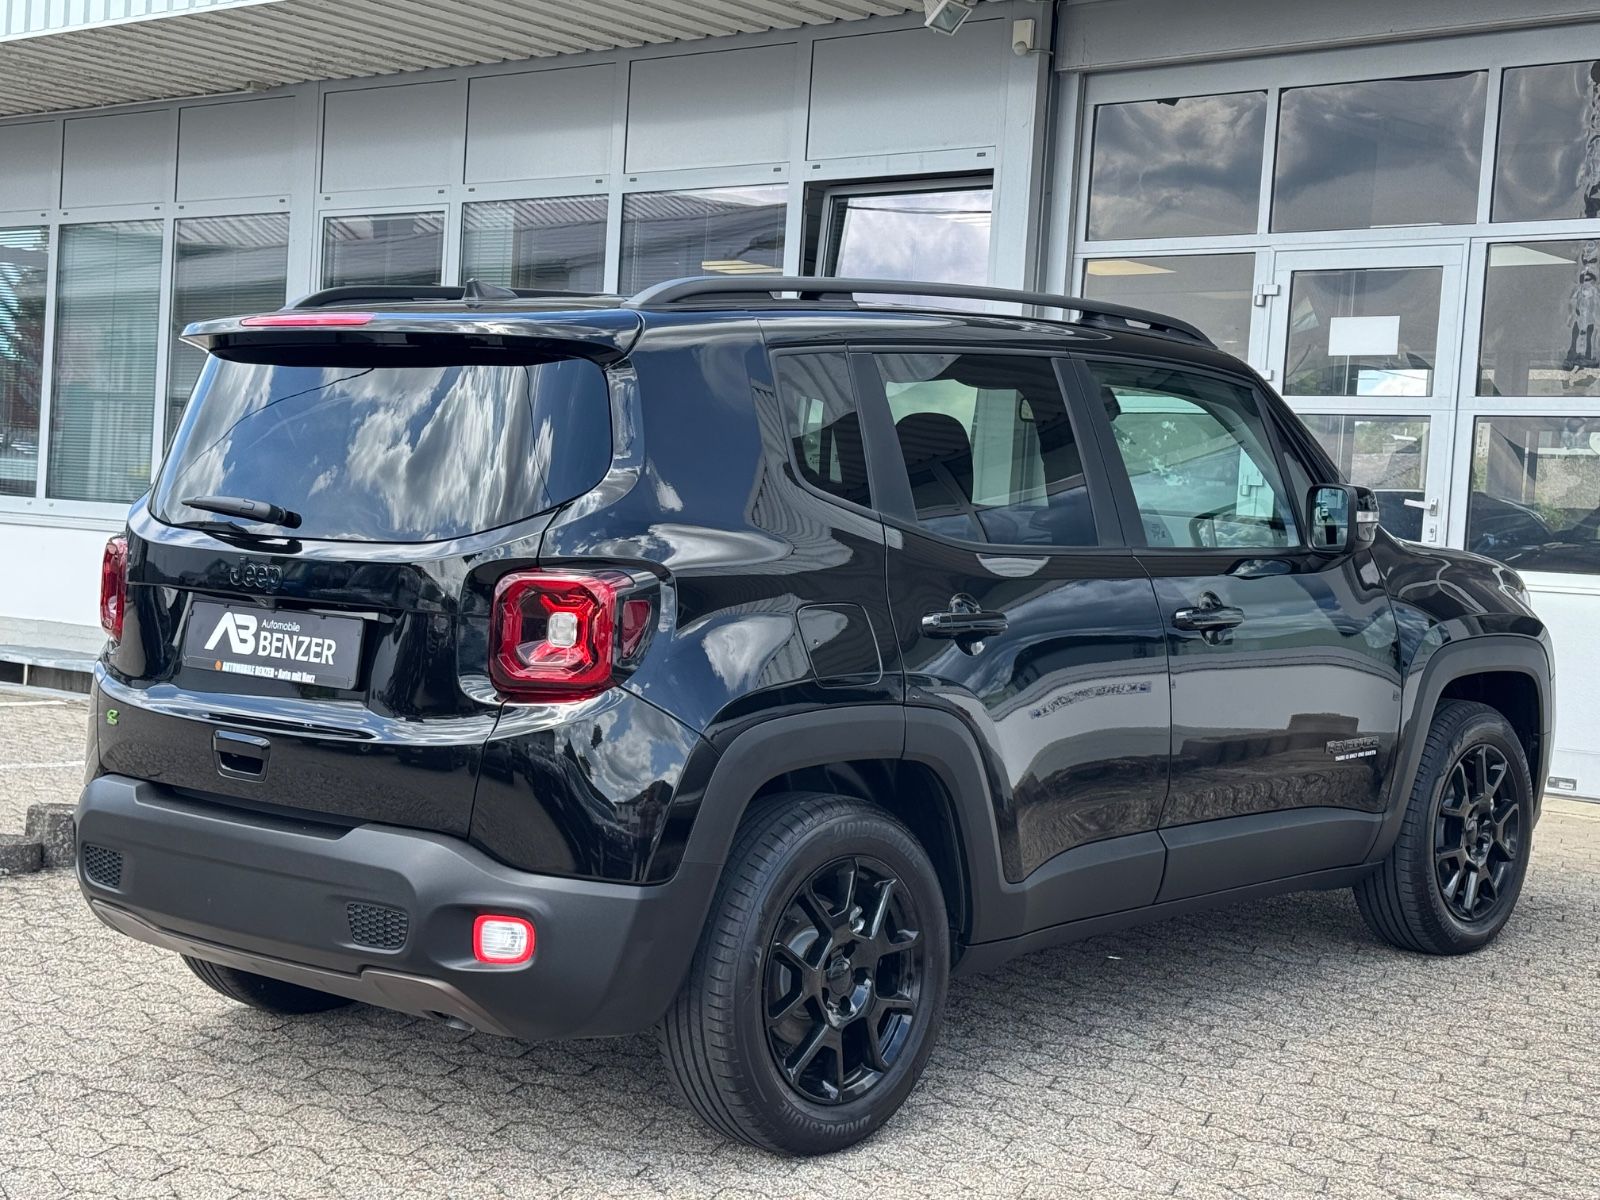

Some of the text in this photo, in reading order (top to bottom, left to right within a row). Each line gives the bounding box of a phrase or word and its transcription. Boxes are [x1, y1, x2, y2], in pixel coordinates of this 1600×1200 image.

[229, 556, 283, 594] Jeep
[261, 619, 301, 633] Automobile
[257, 631, 337, 666] BENZER
